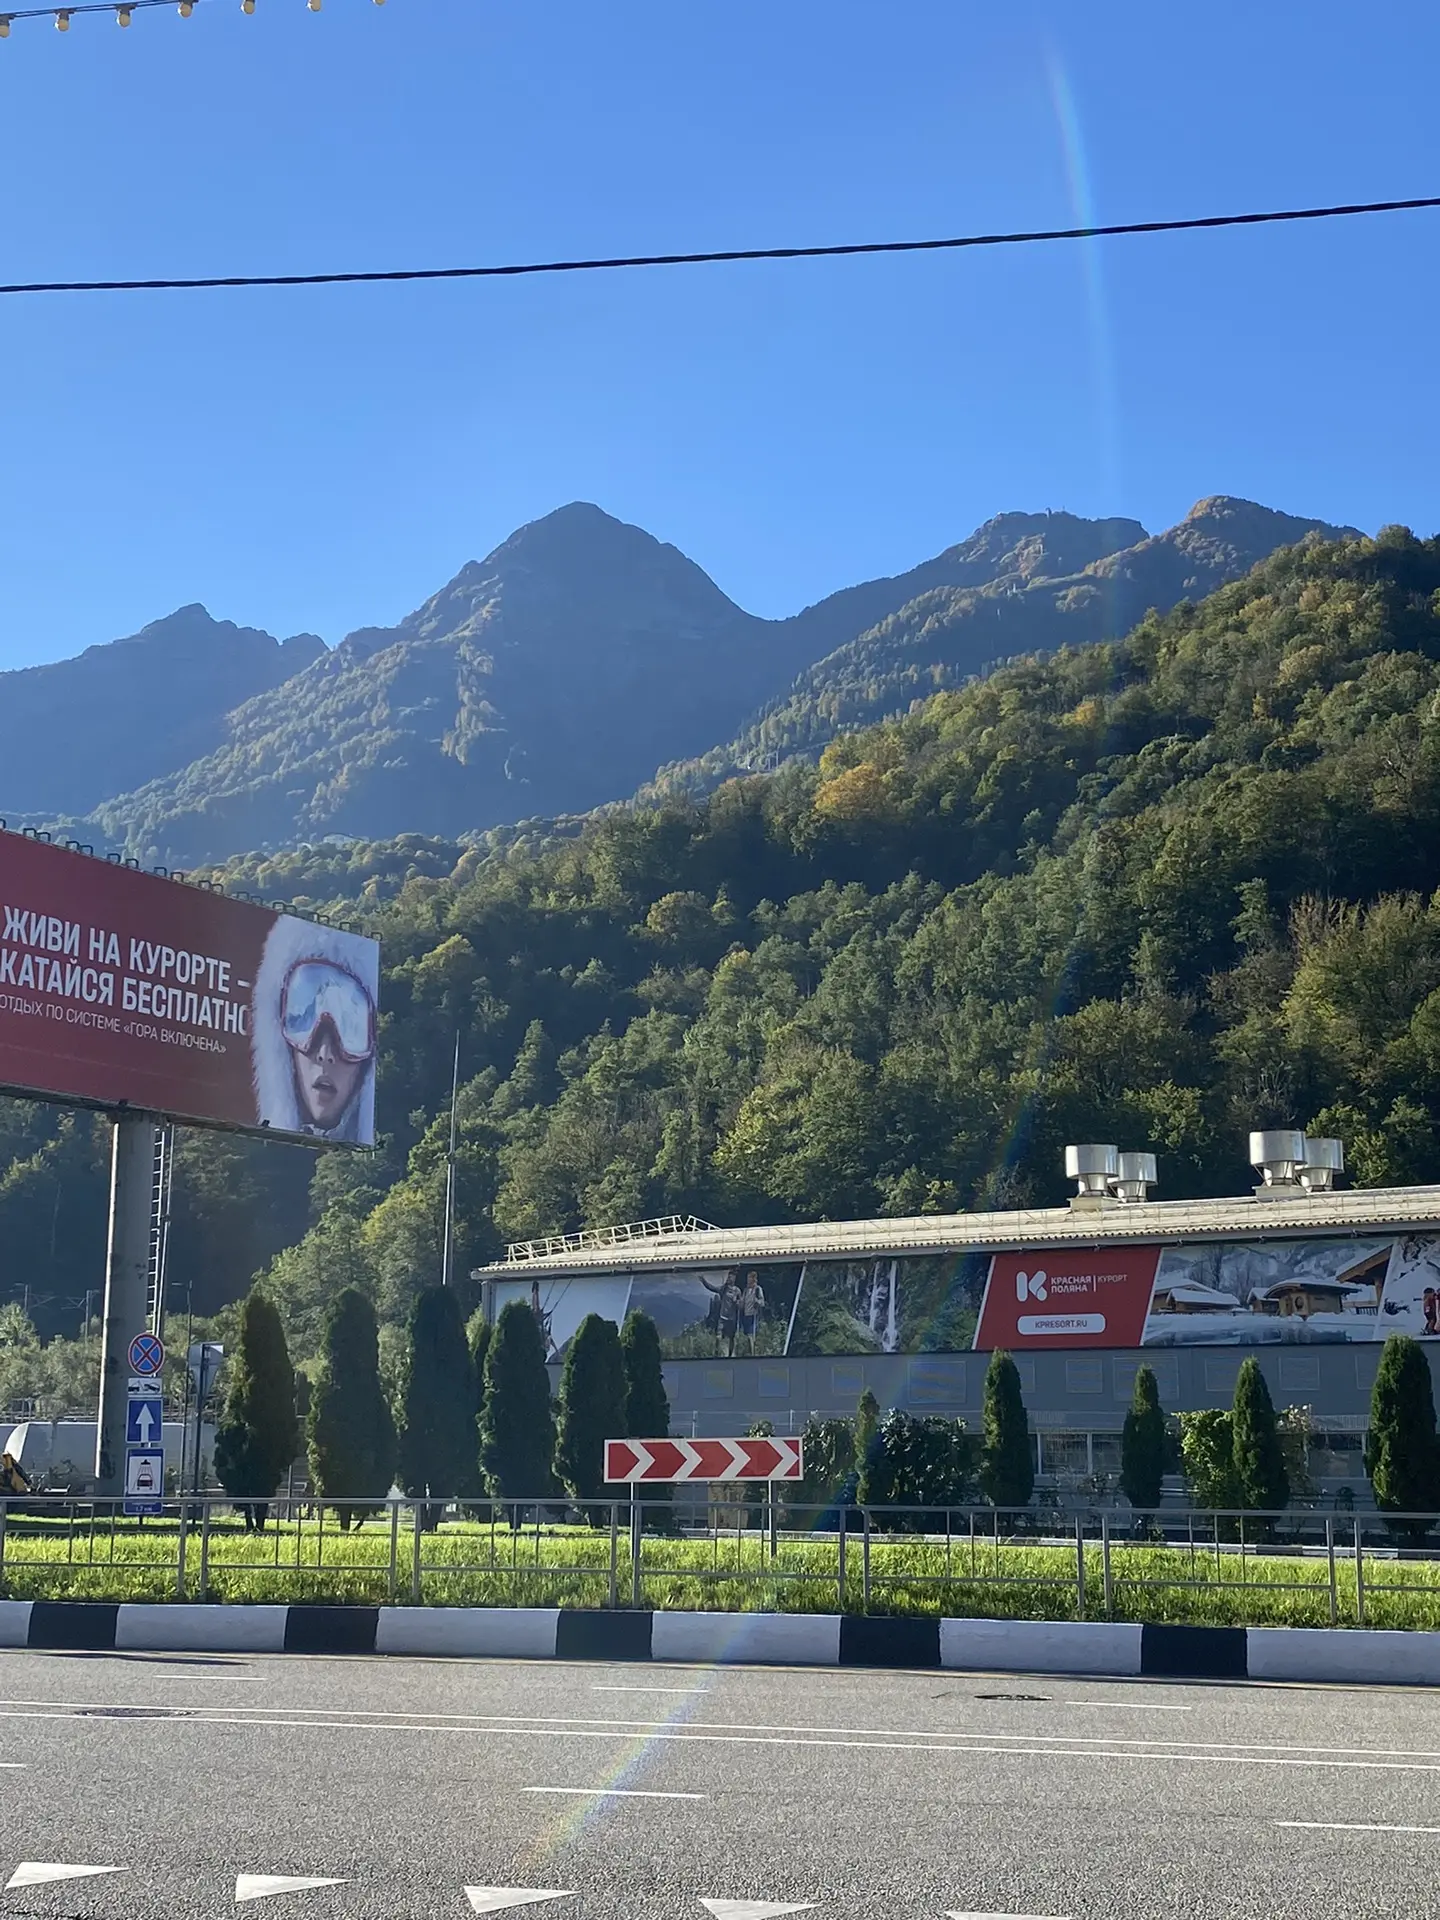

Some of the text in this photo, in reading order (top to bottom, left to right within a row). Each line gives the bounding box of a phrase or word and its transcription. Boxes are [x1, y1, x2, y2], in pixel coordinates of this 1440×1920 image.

[2, 905, 80, 957] ЖИВИ
[89, 928, 121, 967] НА
[129, 938, 231, 994] КУРОРТЕ
[0, 948, 114, 1006] КАТАЙСЯ
[0, 994, 227, 1053] ОТДЫХ ПО СИСТЕМЕ «ГОРА ВКЛЮЧЕНА»
[1050, 1274, 1128, 1285] КРАСНАЯ КУРОРТ
[1050, 1284, 1088, 1294] ПОЛЯНА
[1034, 1319, 1088, 1329] KPRESORT.RU
